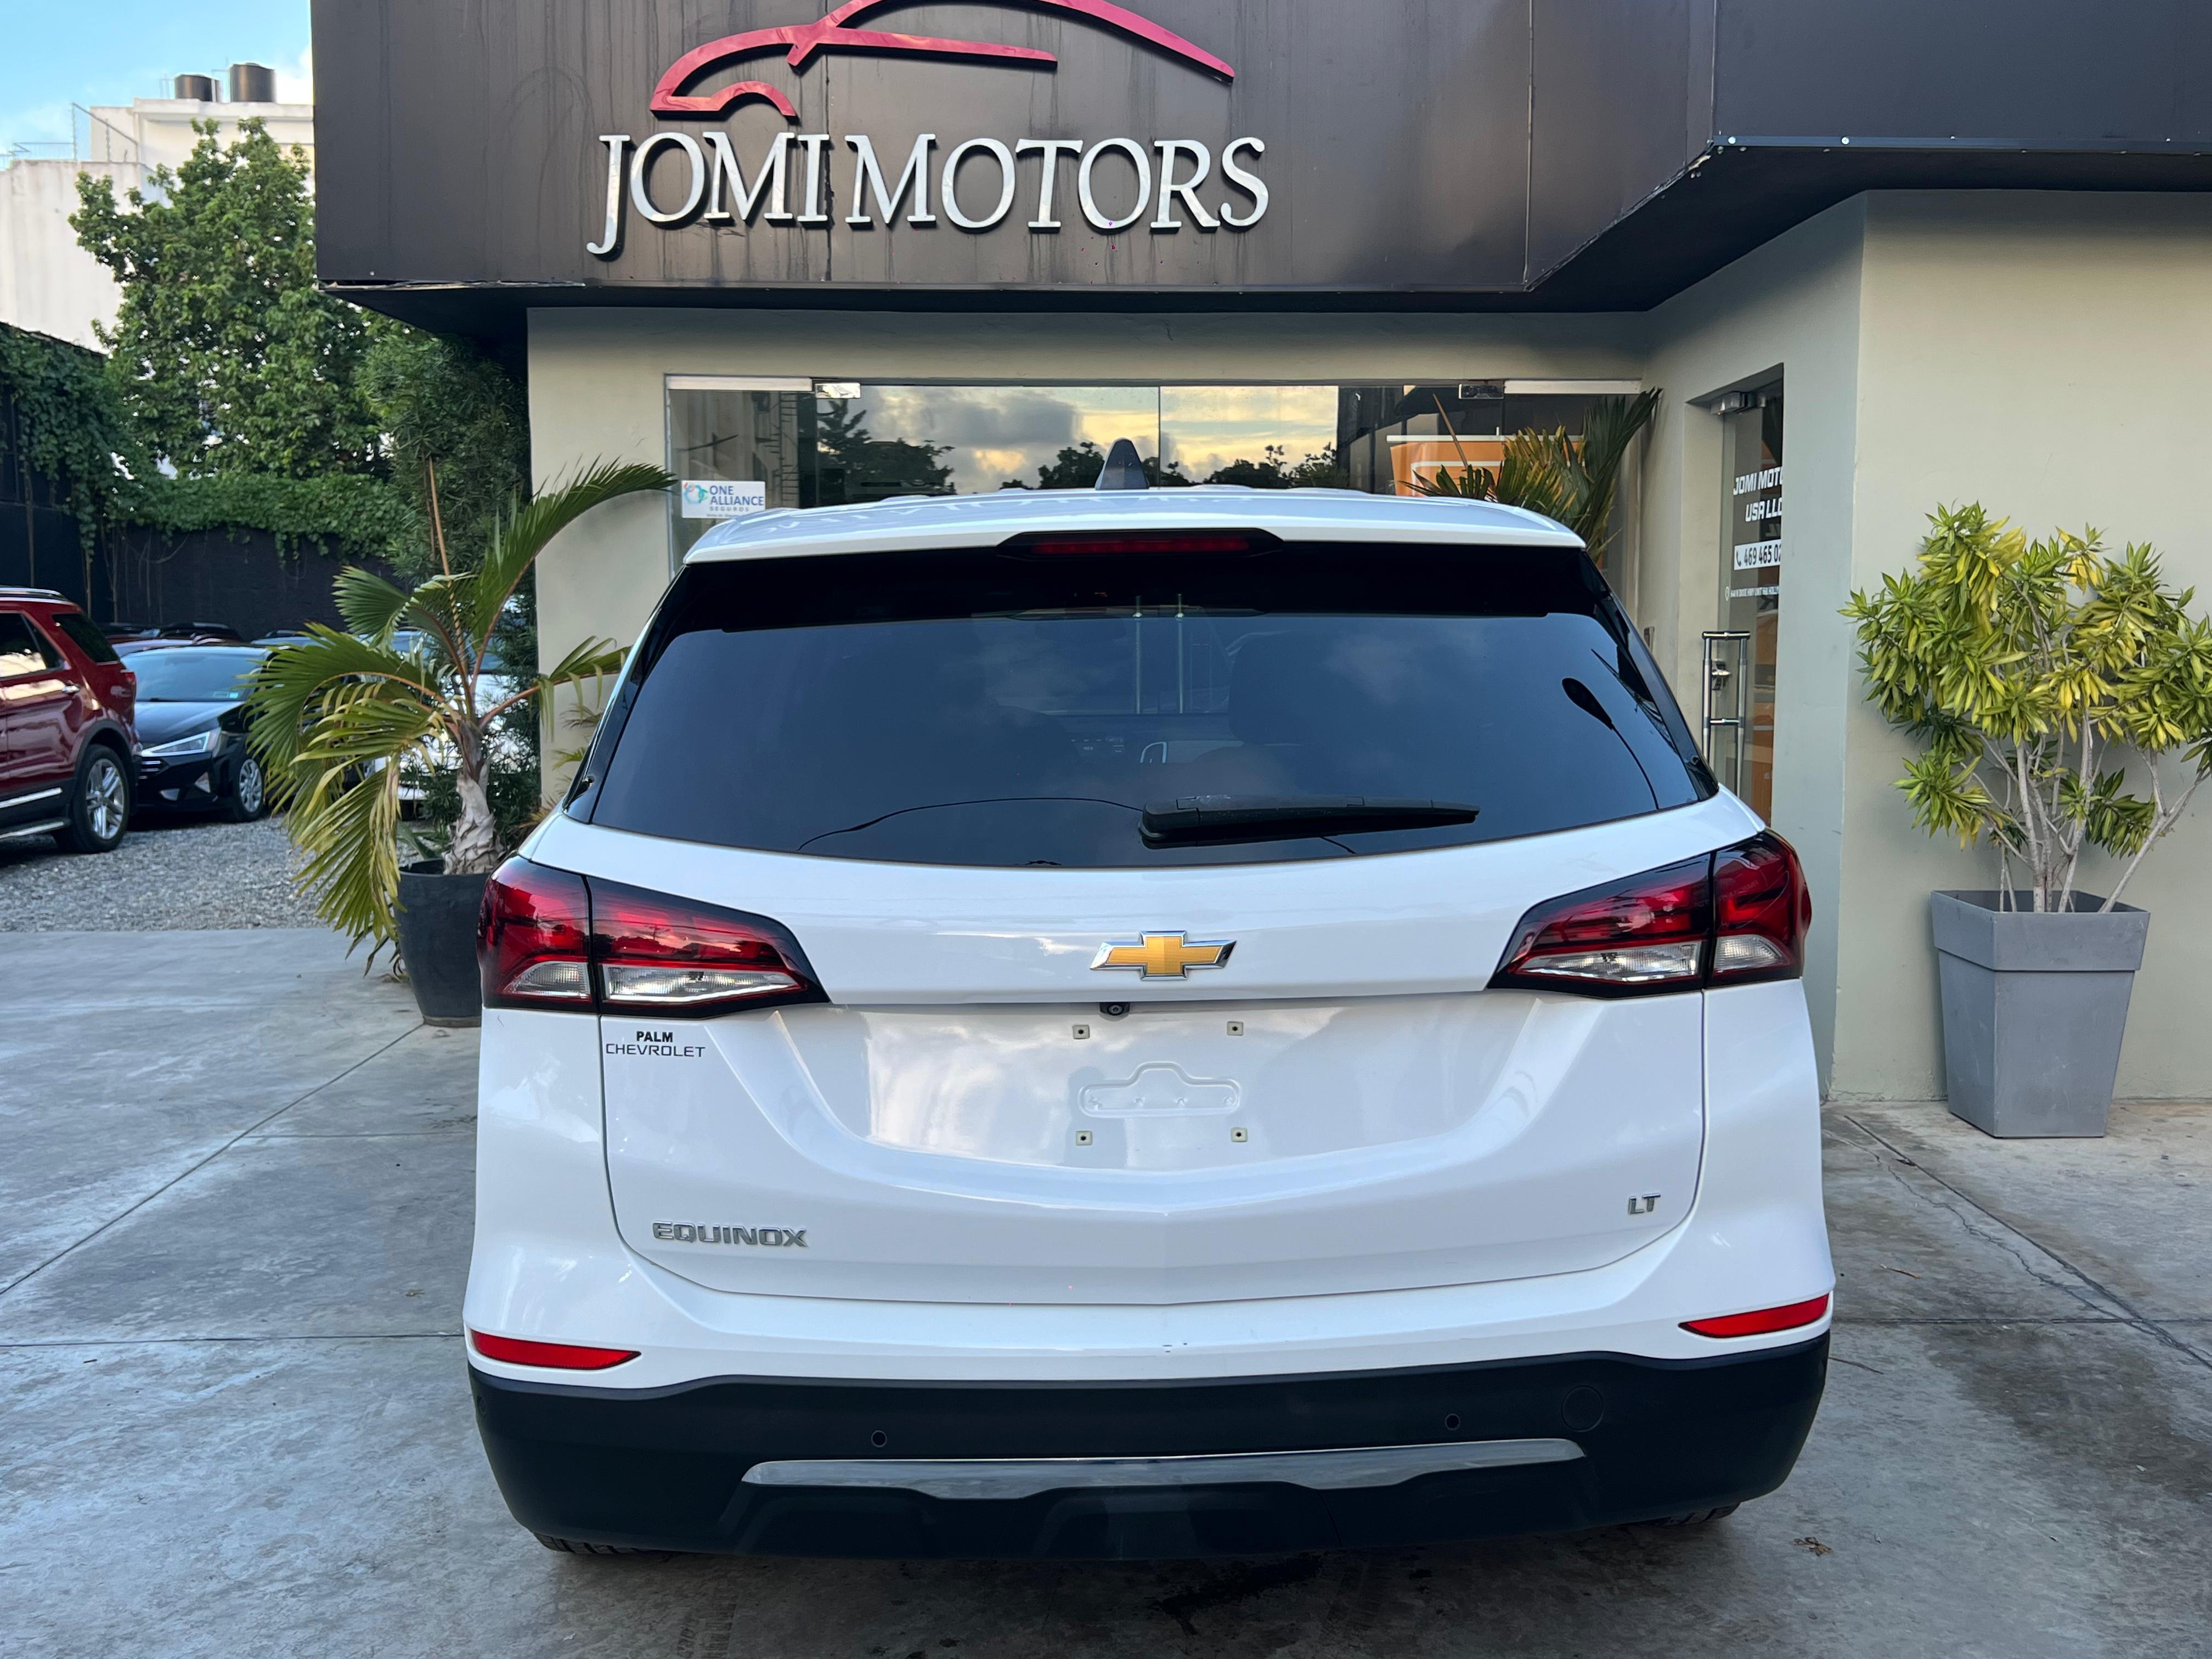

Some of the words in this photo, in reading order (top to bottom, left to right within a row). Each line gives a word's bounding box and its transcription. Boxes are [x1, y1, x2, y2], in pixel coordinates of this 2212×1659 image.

[586, 132, 830, 256] JOMI
[845, 133, 1267, 229] MOTORS
[709, 485, 734, 495] ONE
[1733, 472, 1757, 495] JOMI
[710, 496, 764, 506] ALLIANCE
[1745, 500, 1765, 522] USA
[1744, 547, 1757, 566] 469
[1759, 545, 1772, 564] 465
[636, 1031, 673, 1042] PALM
[606, 1043, 706, 1057] CHEVROLET
[1628, 1193, 1661, 1215] LT
[652, 1220, 809, 1247] EQUINOX
